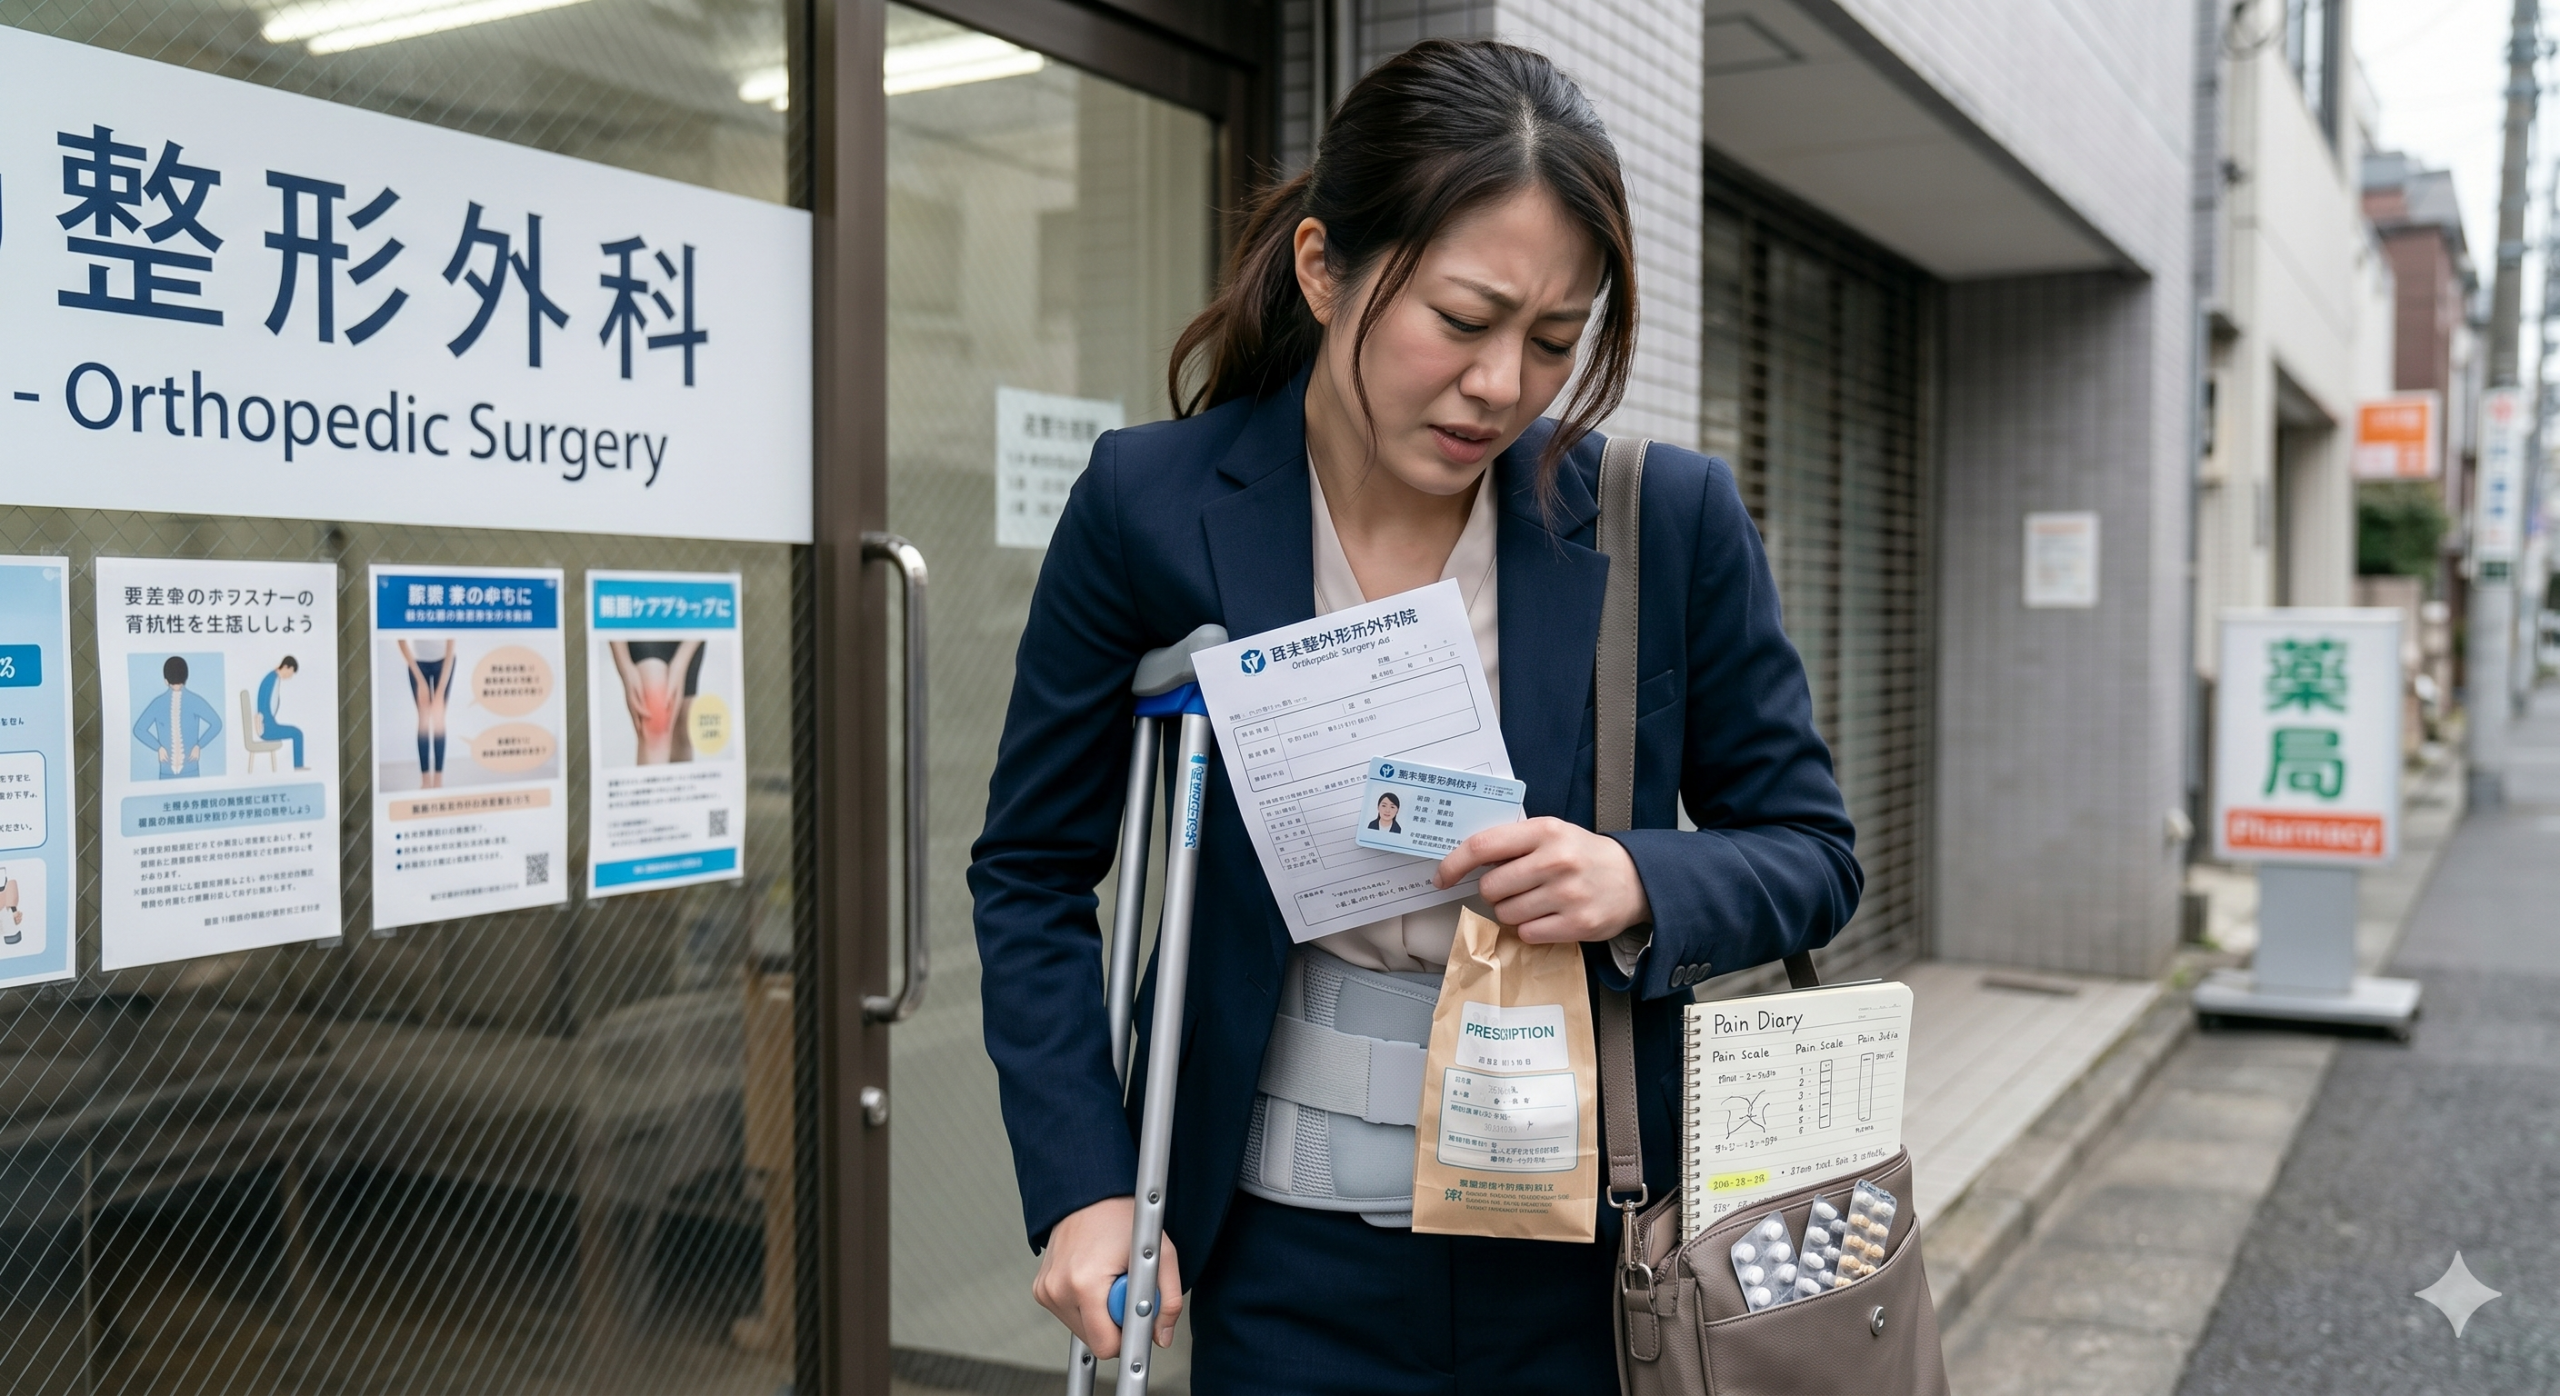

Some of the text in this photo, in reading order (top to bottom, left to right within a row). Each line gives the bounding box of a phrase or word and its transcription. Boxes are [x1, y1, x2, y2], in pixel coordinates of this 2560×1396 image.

[56, 124, 708, 388] 整形外科
[65, 362, 449, 462] Orthopedic
[469, 402, 668, 488] Surgery
[1341, 640, 1376, 657] Surgery
[2266, 638, 2347, 799] 薬局
[2230, 819, 2377, 854] Pharmacy
[1714, 1010, 1803, 1035] Pain Diary
[1795, 1038, 1844, 1055] Pain Scale
[1858, 1034, 1875, 1045] Pain
[1712, 1047, 1770, 1063] Pain Scale
